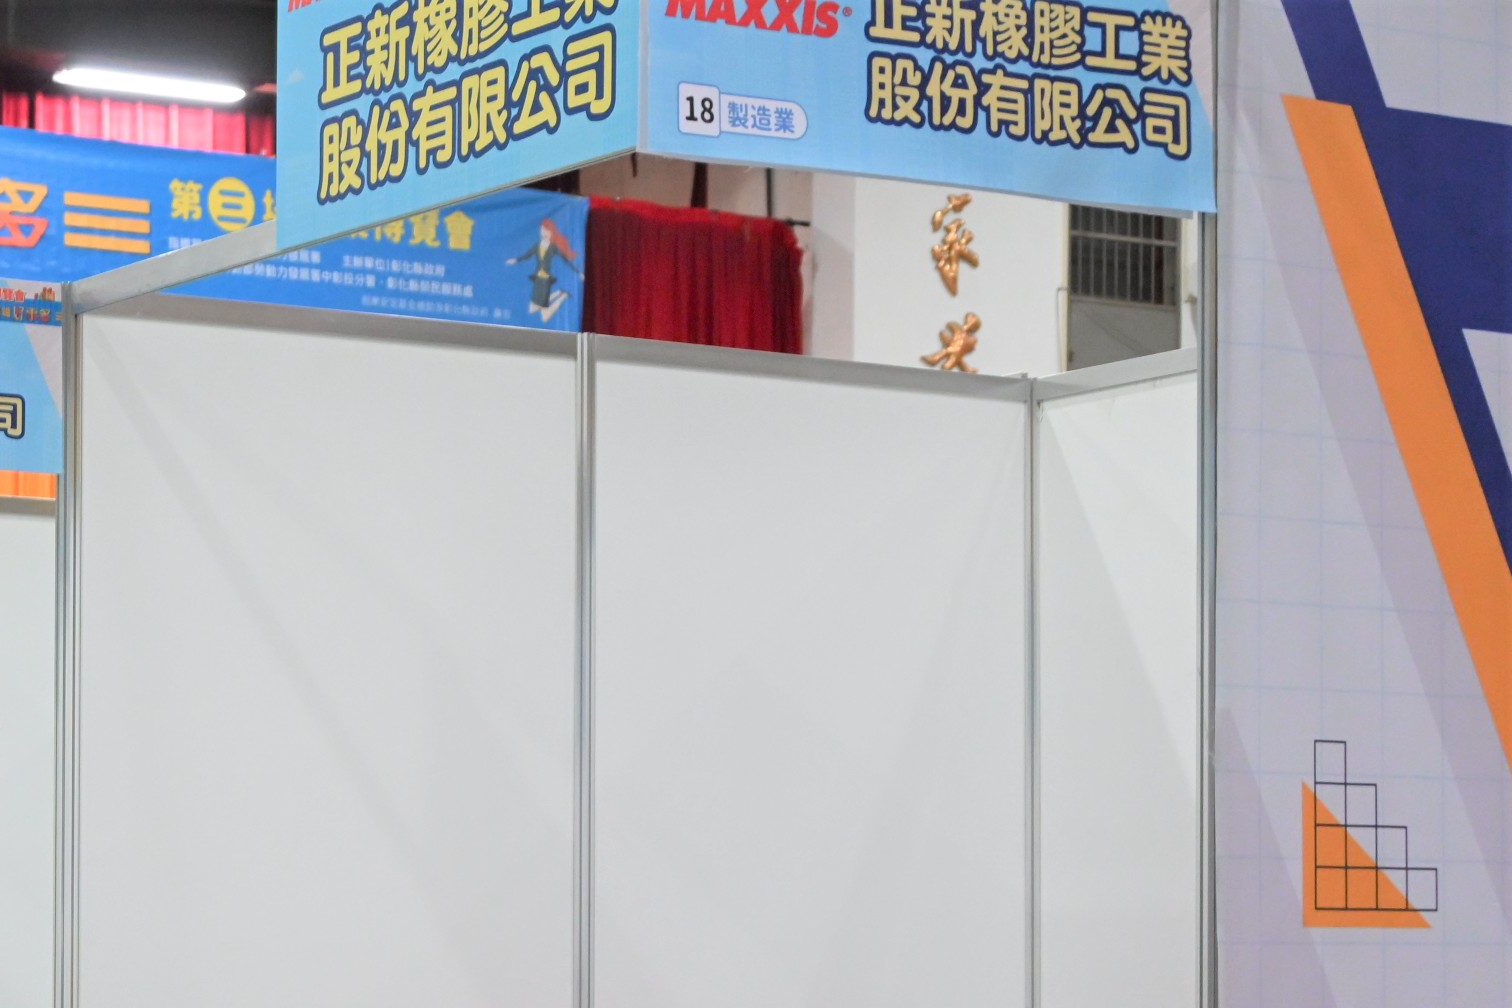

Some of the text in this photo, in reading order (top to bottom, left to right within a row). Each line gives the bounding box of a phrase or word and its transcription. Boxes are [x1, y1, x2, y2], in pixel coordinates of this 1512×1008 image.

[868, 0, 1190, 83] 正新橡膠工業
[319, 30, 616, 202] 股份有限公司
[685, 95, 795, 134] 18 製造業
[868, 56, 1190, 157] 股份有限公司
